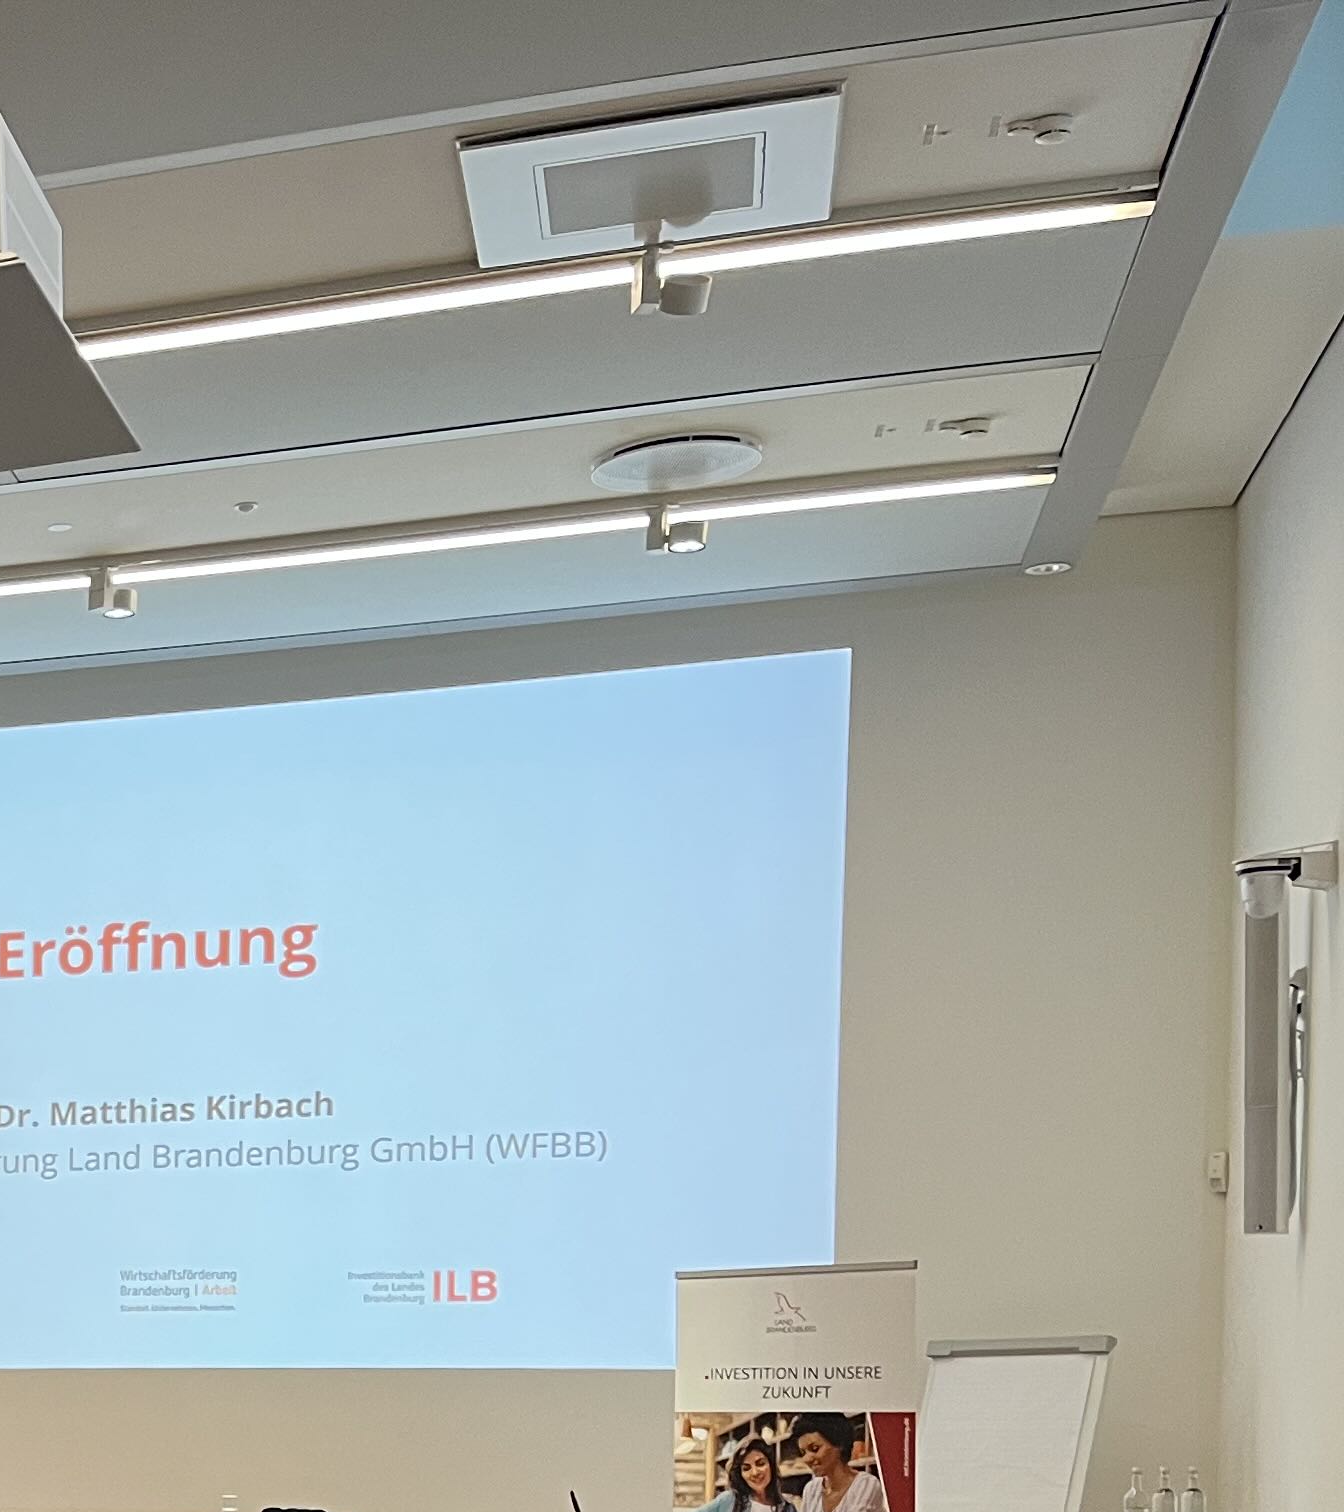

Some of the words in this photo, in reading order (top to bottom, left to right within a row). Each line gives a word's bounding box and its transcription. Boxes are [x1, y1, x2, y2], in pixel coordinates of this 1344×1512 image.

[50, 1097, 196, 1126] Matthias
[206, 1091, 334, 1120] Kirbach
[69, 1144, 141, 1172] Land
[153, 1138, 359, 1171] Brandenburg
[370, 1134, 474, 1163] GmbH
[486, 1131, 608, 1165] (WFBB)
[120, 1269, 237, 1282] Wirtschaftsförderung
[120, 1284, 190, 1299] Brandenburg
[433, 1270, 497, 1302] ILB
[803, 1367, 819, 1379] IN
[824, 1366, 882, 1379] UNSERE
[762, 1386, 831, 1399] ZUKUNFT
